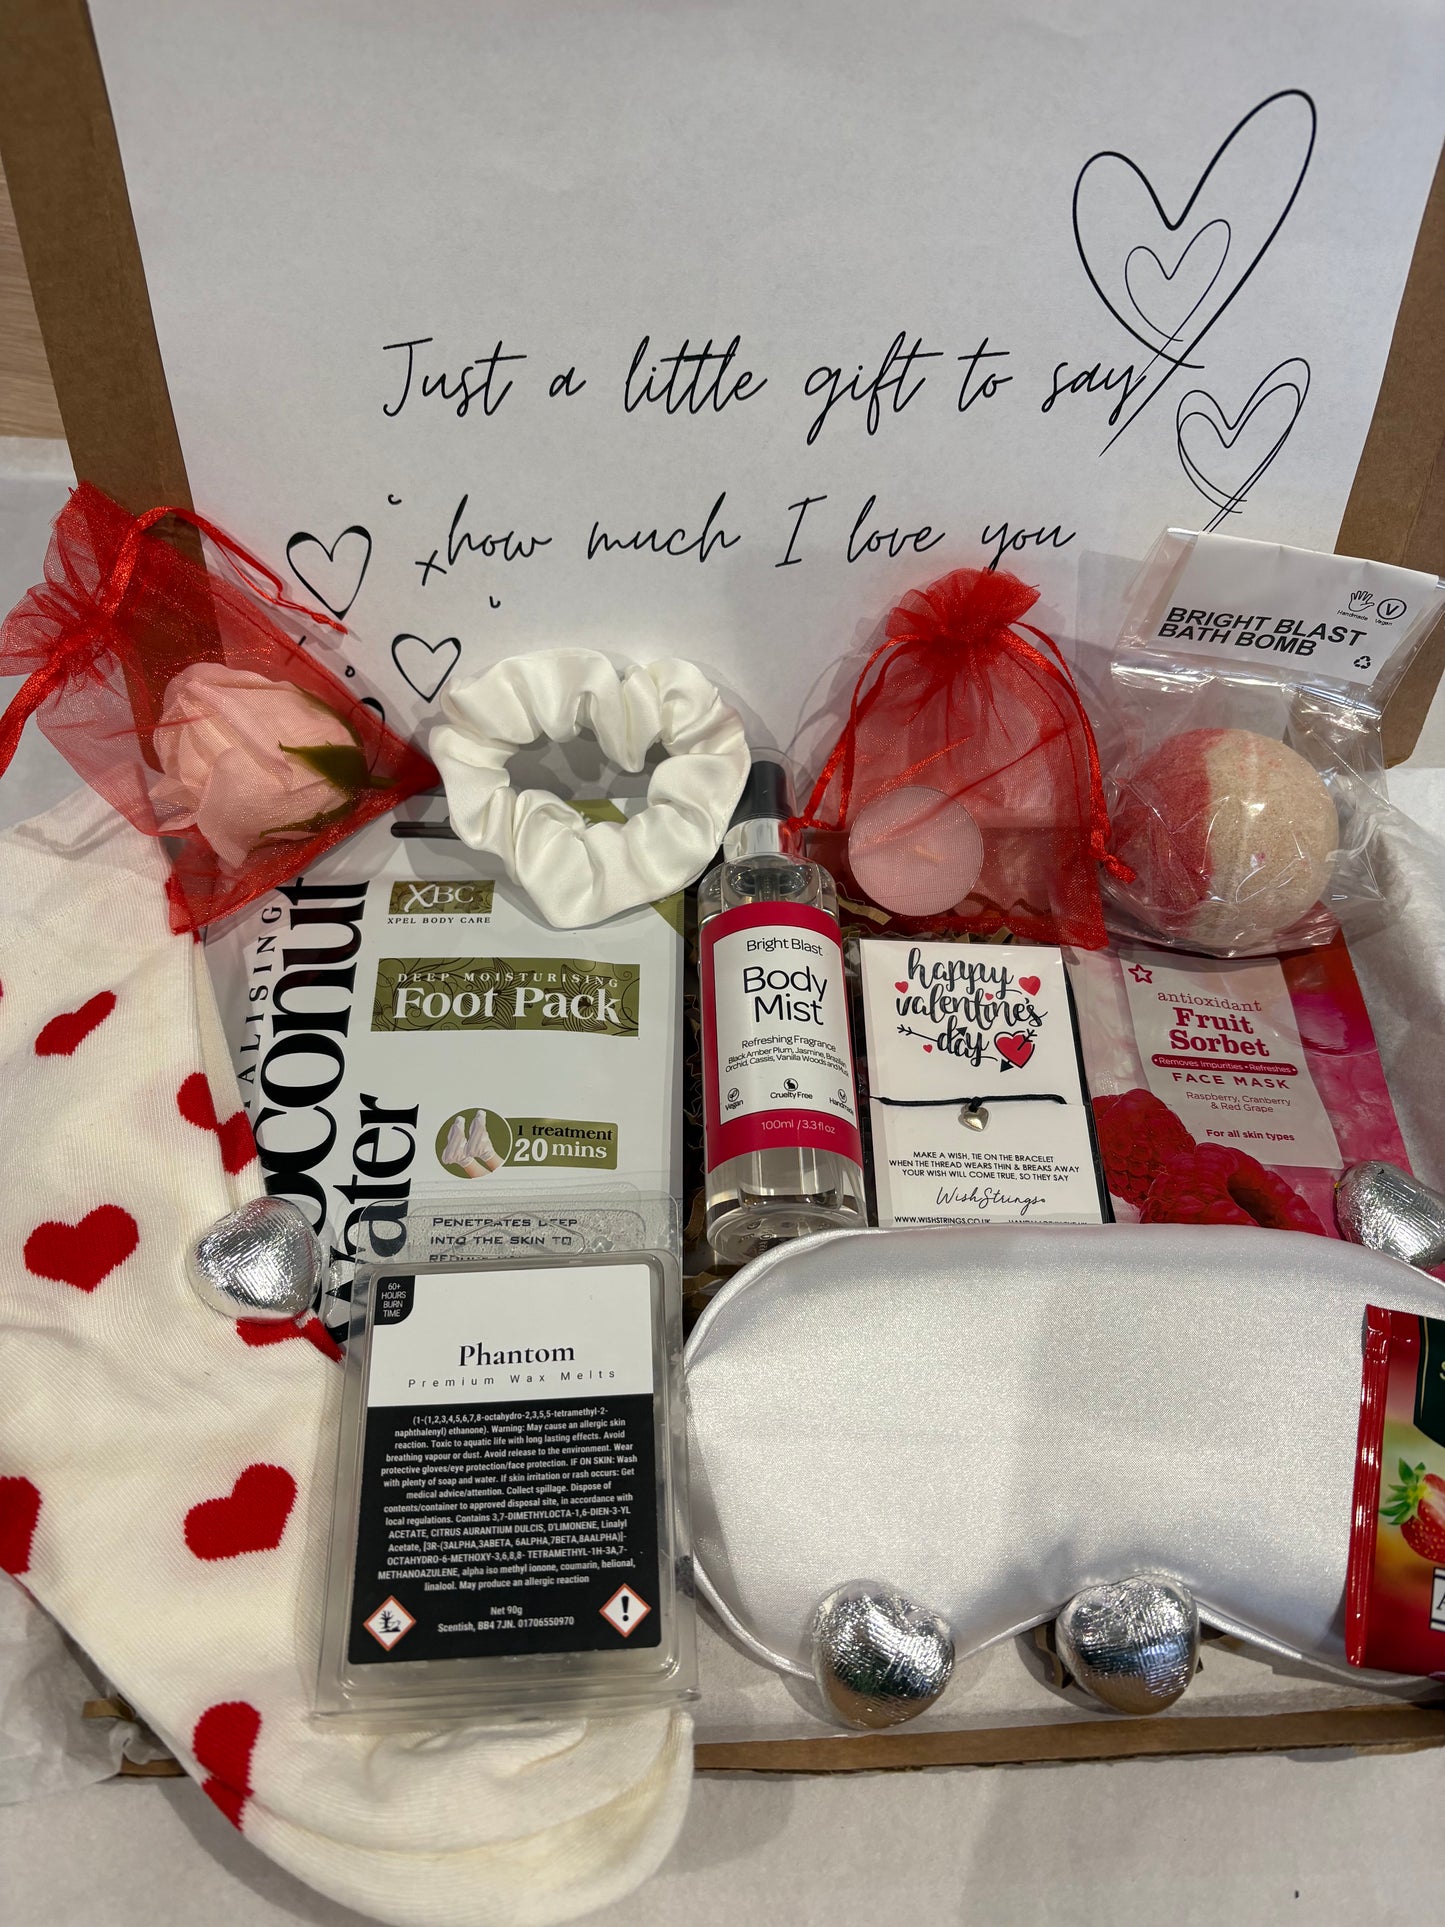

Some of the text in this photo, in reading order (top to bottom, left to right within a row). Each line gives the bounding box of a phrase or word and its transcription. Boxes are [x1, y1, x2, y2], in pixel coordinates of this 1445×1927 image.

[384, 331, 1146, 445] Just a little gift to say
[448, 492, 1076, 576] how much I love you
[1166, 606, 1368, 647] BRIGHT BLAST
[1158, 623, 1318, 657] BATH BOMB
[403, 883, 475, 913] XBC
[387, 916, 491, 925] XPEL BODY CARE
[746, 937, 824, 956] Bright Blast
[398, 973, 619, 988] DEEP MOISTURISING
[908, 947, 1023, 998] happy
[743, 965, 828, 1002] Body
[236, 906, 282, 1108] ALISING
[393, 987, 623, 1024] Foot Pack
[754, 993, 824, 1025] Mist
[896, 984, 1048, 1030] valentine's
[1157, 992, 1262, 1012] antioxidant
[1172, 1007, 1254, 1034] Fruit
[741, 1035, 836, 1052] Refreshing Fragrance
[937, 1014, 998, 1067] day
[1169, 1029, 1270, 1057] Sorbet
[728, 1053, 746, 1064] Black
[746, 1048, 772, 1057] Amber
[772, 1046, 794, 1054] Plum,
[795, 1047, 825, 1059] Jasmine,
[749, 1055, 775, 1065] Cassis,
[802, 1055, 827, 1067] Woods
[1159, 1057, 1291, 1073] Removes Impurities Refreshes
[1172, 1072, 1291, 1089] FACE MASK
[770, 1091, 813, 1100] Cruelty Free
[1186, 1091, 1291, 1106] Raspberry, Cranberry
[725, 1099, 744, 1111] Vegan
[1211, 1102, 1274, 1113] & Red Grape
[532, 1124, 613, 1141] treatment
[761, 1120, 794, 1130] 100ml
[1206, 1129, 1295, 1141] For all skin types
[514, 1138, 608, 1162] 20 mins
[913, 1151, 937, 1159] MAKE
[947, 1152, 970, 1160] WISH,
[1014, 1154, 1054, 1163] BRACELET
[902, 1169, 925, 1177] YOUR
[948, 1170, 966, 1178] WILL
[968, 1171, 995, 1179] COME
[996, 1172, 1017, 1181] TRUE,
[1032, 1173, 1051, 1181] THEY
[1053, 1174, 1069, 1182] SAY
[964, 1162, 992, 1170] WEARS
[1014, 1163, 1020, 1171] &
[1022, 1164, 1051, 1172] BREAKS
[430, 1236, 467, 1245] INTO
[473, 1236, 503, 1245] THE
[510, 1236, 545, 1245] SKIN
[381, 1290, 406, 1299] HOURS
[387, 1282, 401, 1291] 60+
[383, 1300, 403, 1309] BURN
[383, 1309, 400, 1318] TIME
[458, 1342, 576, 1367] Phantom
[408, 1369, 616, 1388] Premium Wax Melts
[394, 1427, 447, 1438] naphthalenyl)
[448, 1425, 489, 1435] ethanone).
[491, 1424, 525, 1434] Warning:
[526, 1423, 543, 1432] May
[579, 1419, 608, 1429] allergic
[609, 1418, 626, 1427] skin
[394, 1441, 429, 1449] reaction.
[431, 1439, 452, 1448] Toxic
[463, 1438, 492, 1448] aquatic
[493, 1436, 506, 1445] life
[508, 1436, 525, 1444] with
[525, 1435, 543, 1445] long
[544, 1434, 571, 1443] lasting
[572, 1432, 601, 1441] effects.
[603, 1430, 625, 1439] Avoid
[385, 1506, 631, 1526] local regulations. Contains 3,7-DIMETHYLOCTA-1,6-DIEN-3-YL
[424, 1575, 590, 1591] linalool. May produce an allergic reaction
[490, 1605, 523, 1616] Net 90g
[437, 1616, 575, 1632] Scentish, BB4 7JN. 01706550970
